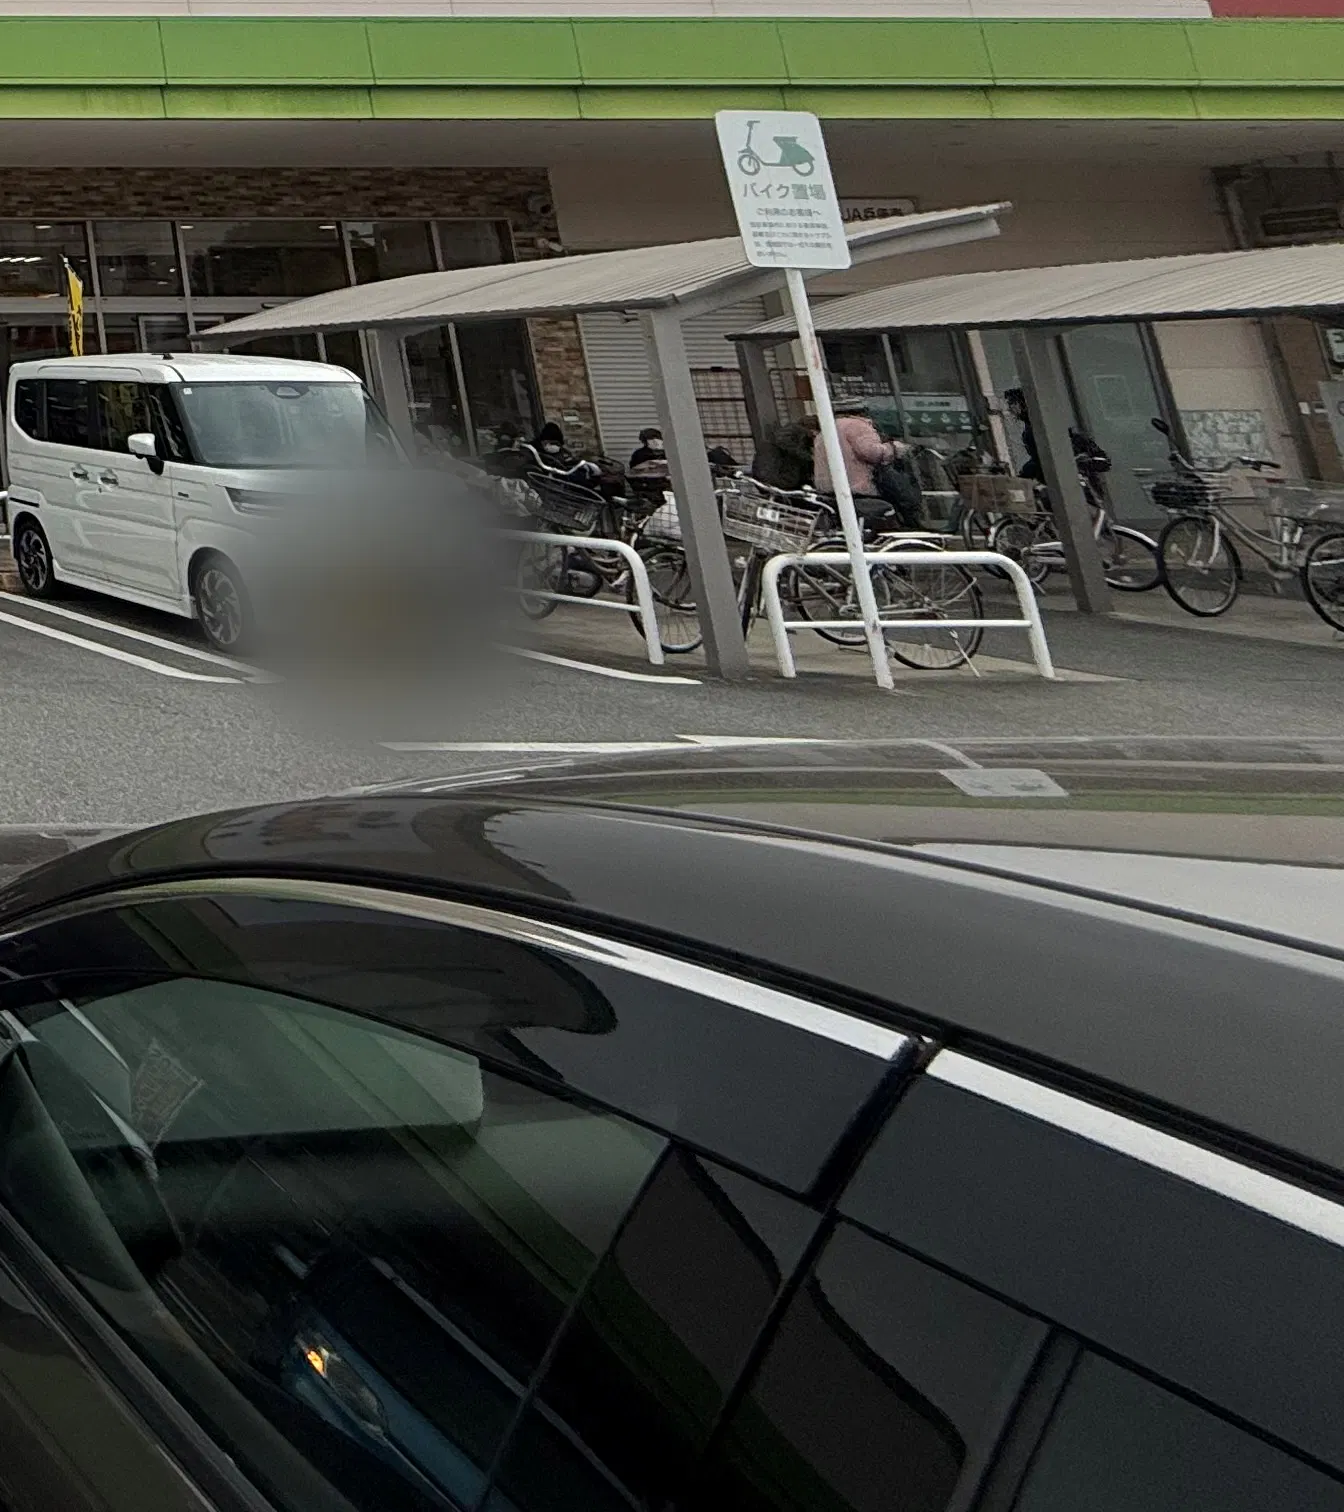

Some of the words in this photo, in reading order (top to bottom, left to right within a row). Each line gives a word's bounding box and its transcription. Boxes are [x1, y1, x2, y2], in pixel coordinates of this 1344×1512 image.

[742, 182, 827, 200] バイク置場
